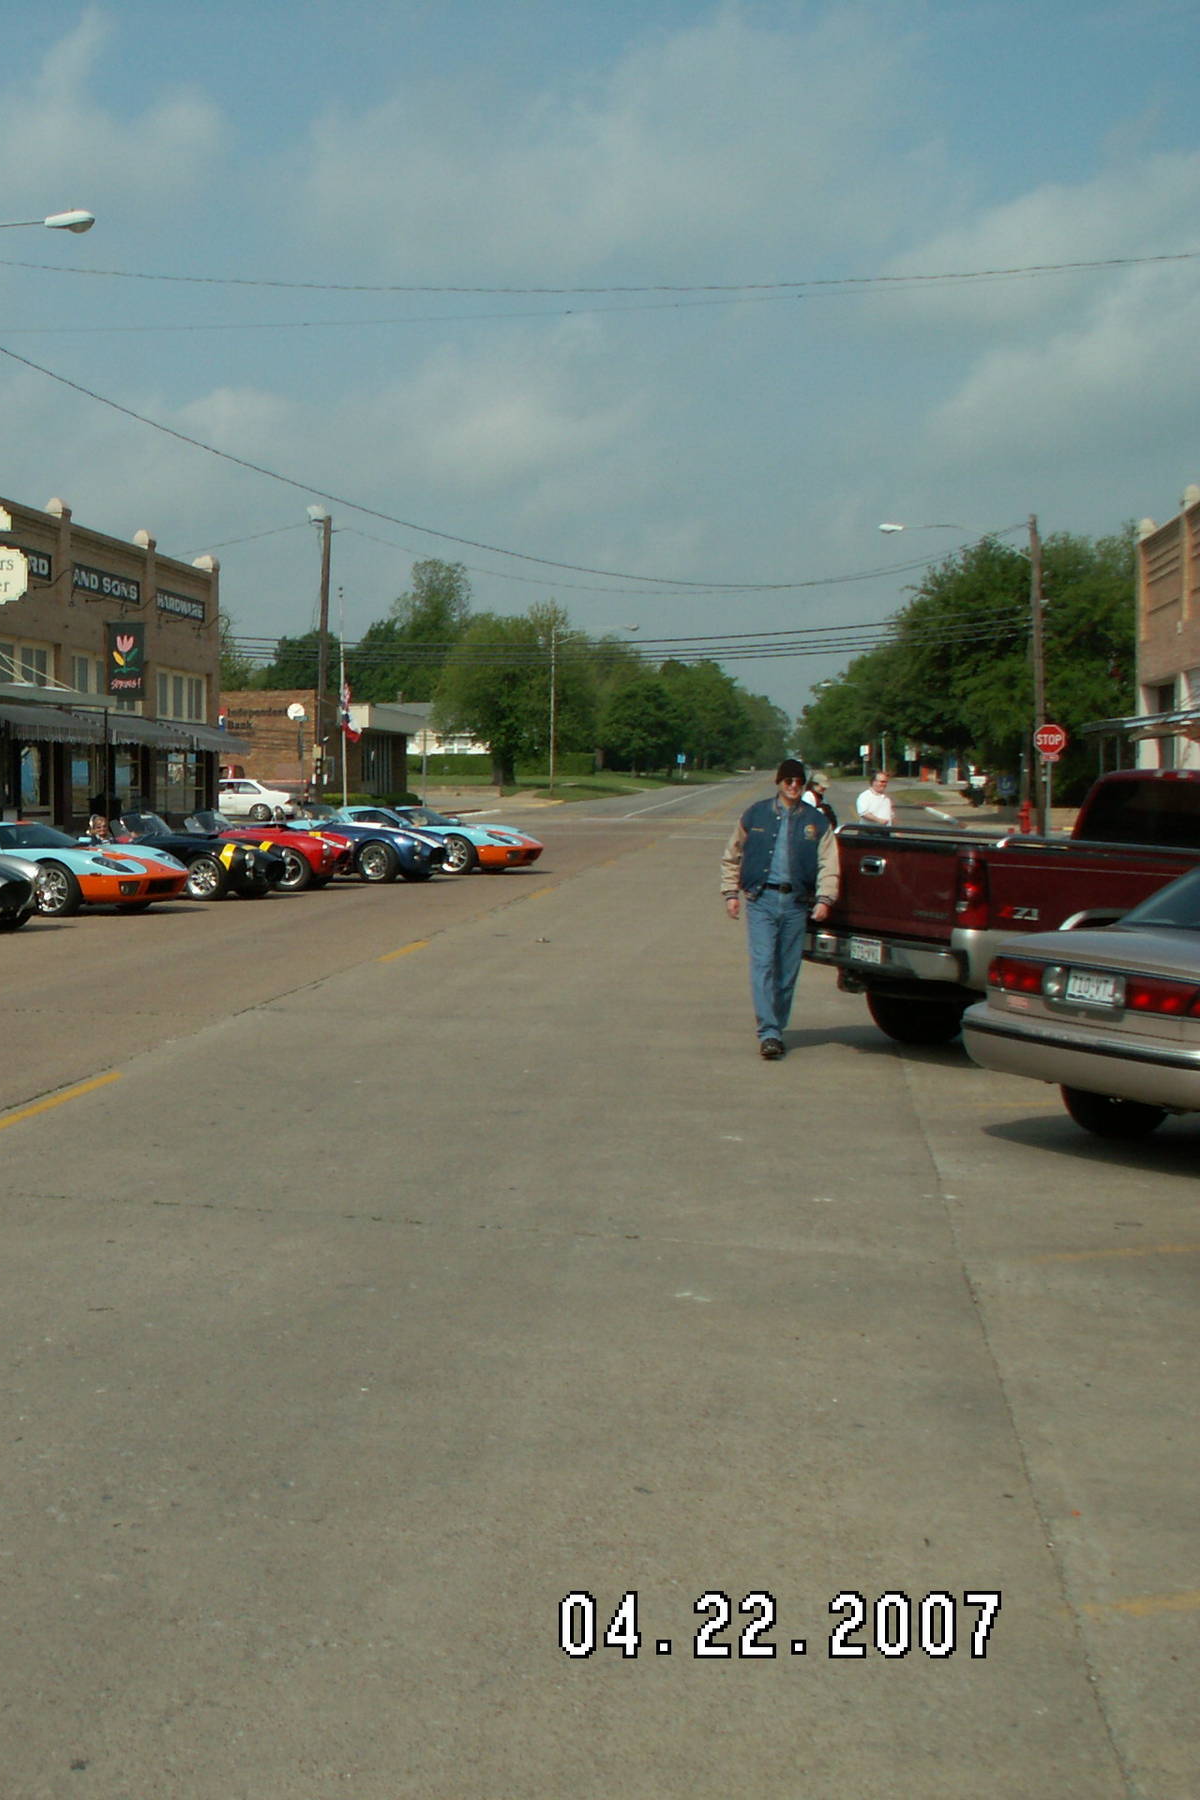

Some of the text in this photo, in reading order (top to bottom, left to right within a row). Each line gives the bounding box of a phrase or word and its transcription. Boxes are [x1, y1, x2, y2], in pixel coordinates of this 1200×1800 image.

[72, 568, 138, 600] AND SONS
[1036, 734, 1062, 745] STOP
